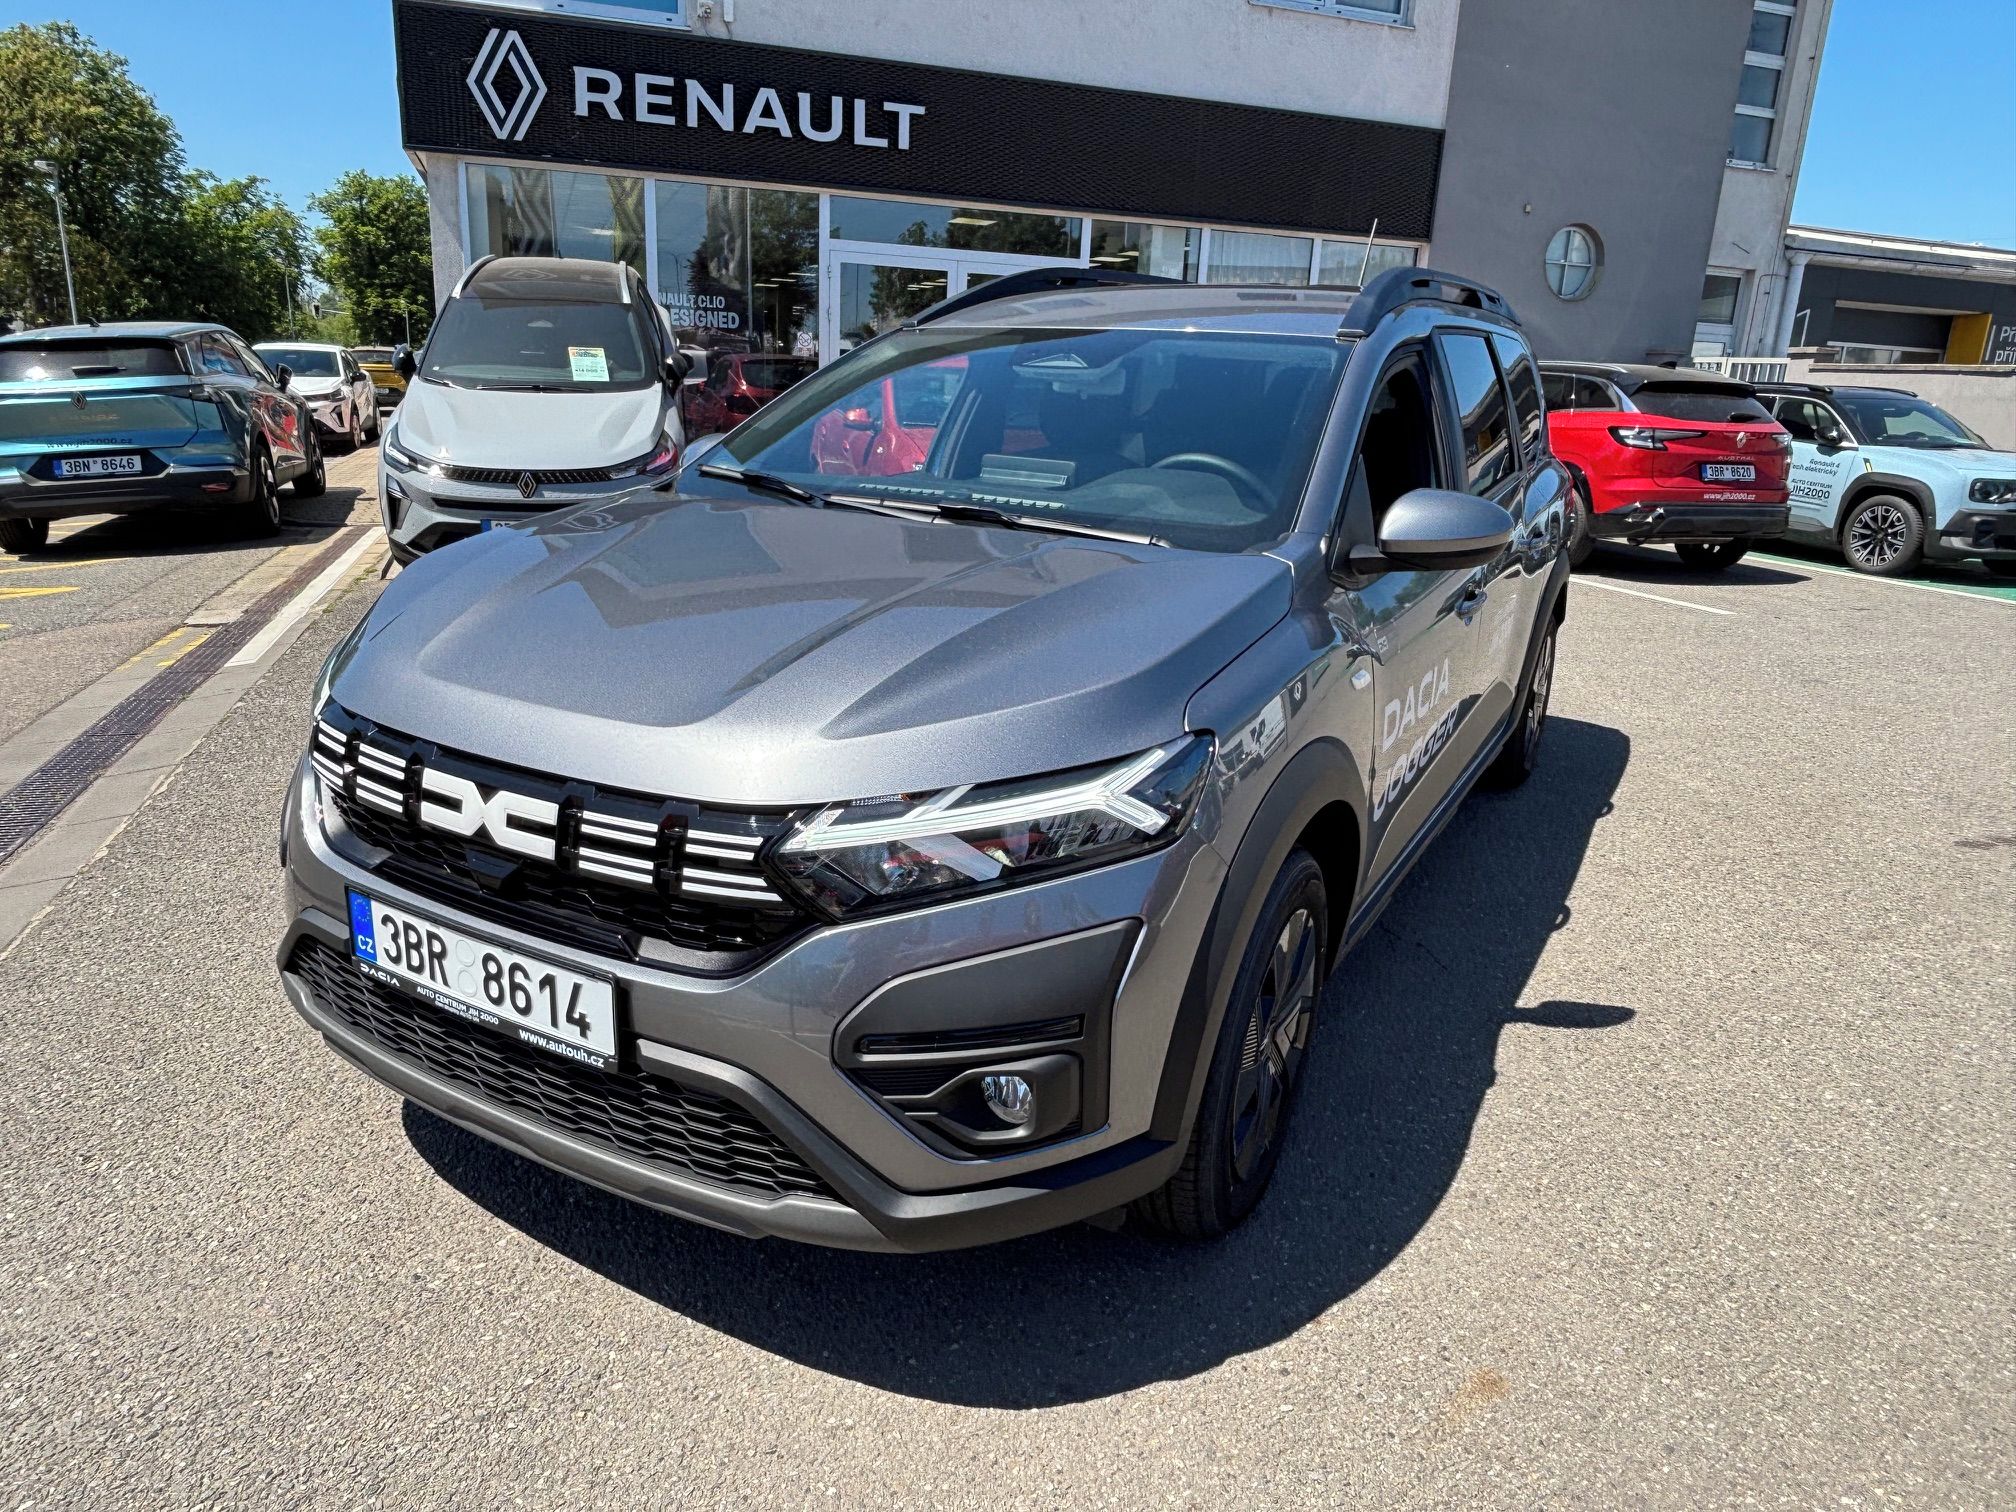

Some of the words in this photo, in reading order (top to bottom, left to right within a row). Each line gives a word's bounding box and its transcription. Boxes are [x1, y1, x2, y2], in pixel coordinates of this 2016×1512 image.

[572, 65, 926, 150] RENAULT
[698, 294, 726, 309] CLIO
[65, 461, 91, 473] 3BN
[101, 457, 135, 471] 8646
[1709, 466, 1724, 477] 3BR
[1731, 466, 1752, 478] 8620
[1790, 484, 1831, 499] JIH2000
[1806, 480, 1833, 489] CENTRUM
[1383, 657, 1449, 753] DACIA
[1373, 700, 1460, 822] JOGGER
[357, 934, 375, 954] CZ
[360, 963, 400, 987] DACIA
[380, 913, 450, 989] 3BR
[481, 952, 592, 1041] 8614
[416, 986, 435, 999] AUTO
[435, 993, 467, 1012] CENTRUM
[468, 1006, 479, 1017] JIH
[480, 1010, 499, 1025] 2000
[519, 1028, 605, 1068] www.autouh.cz
